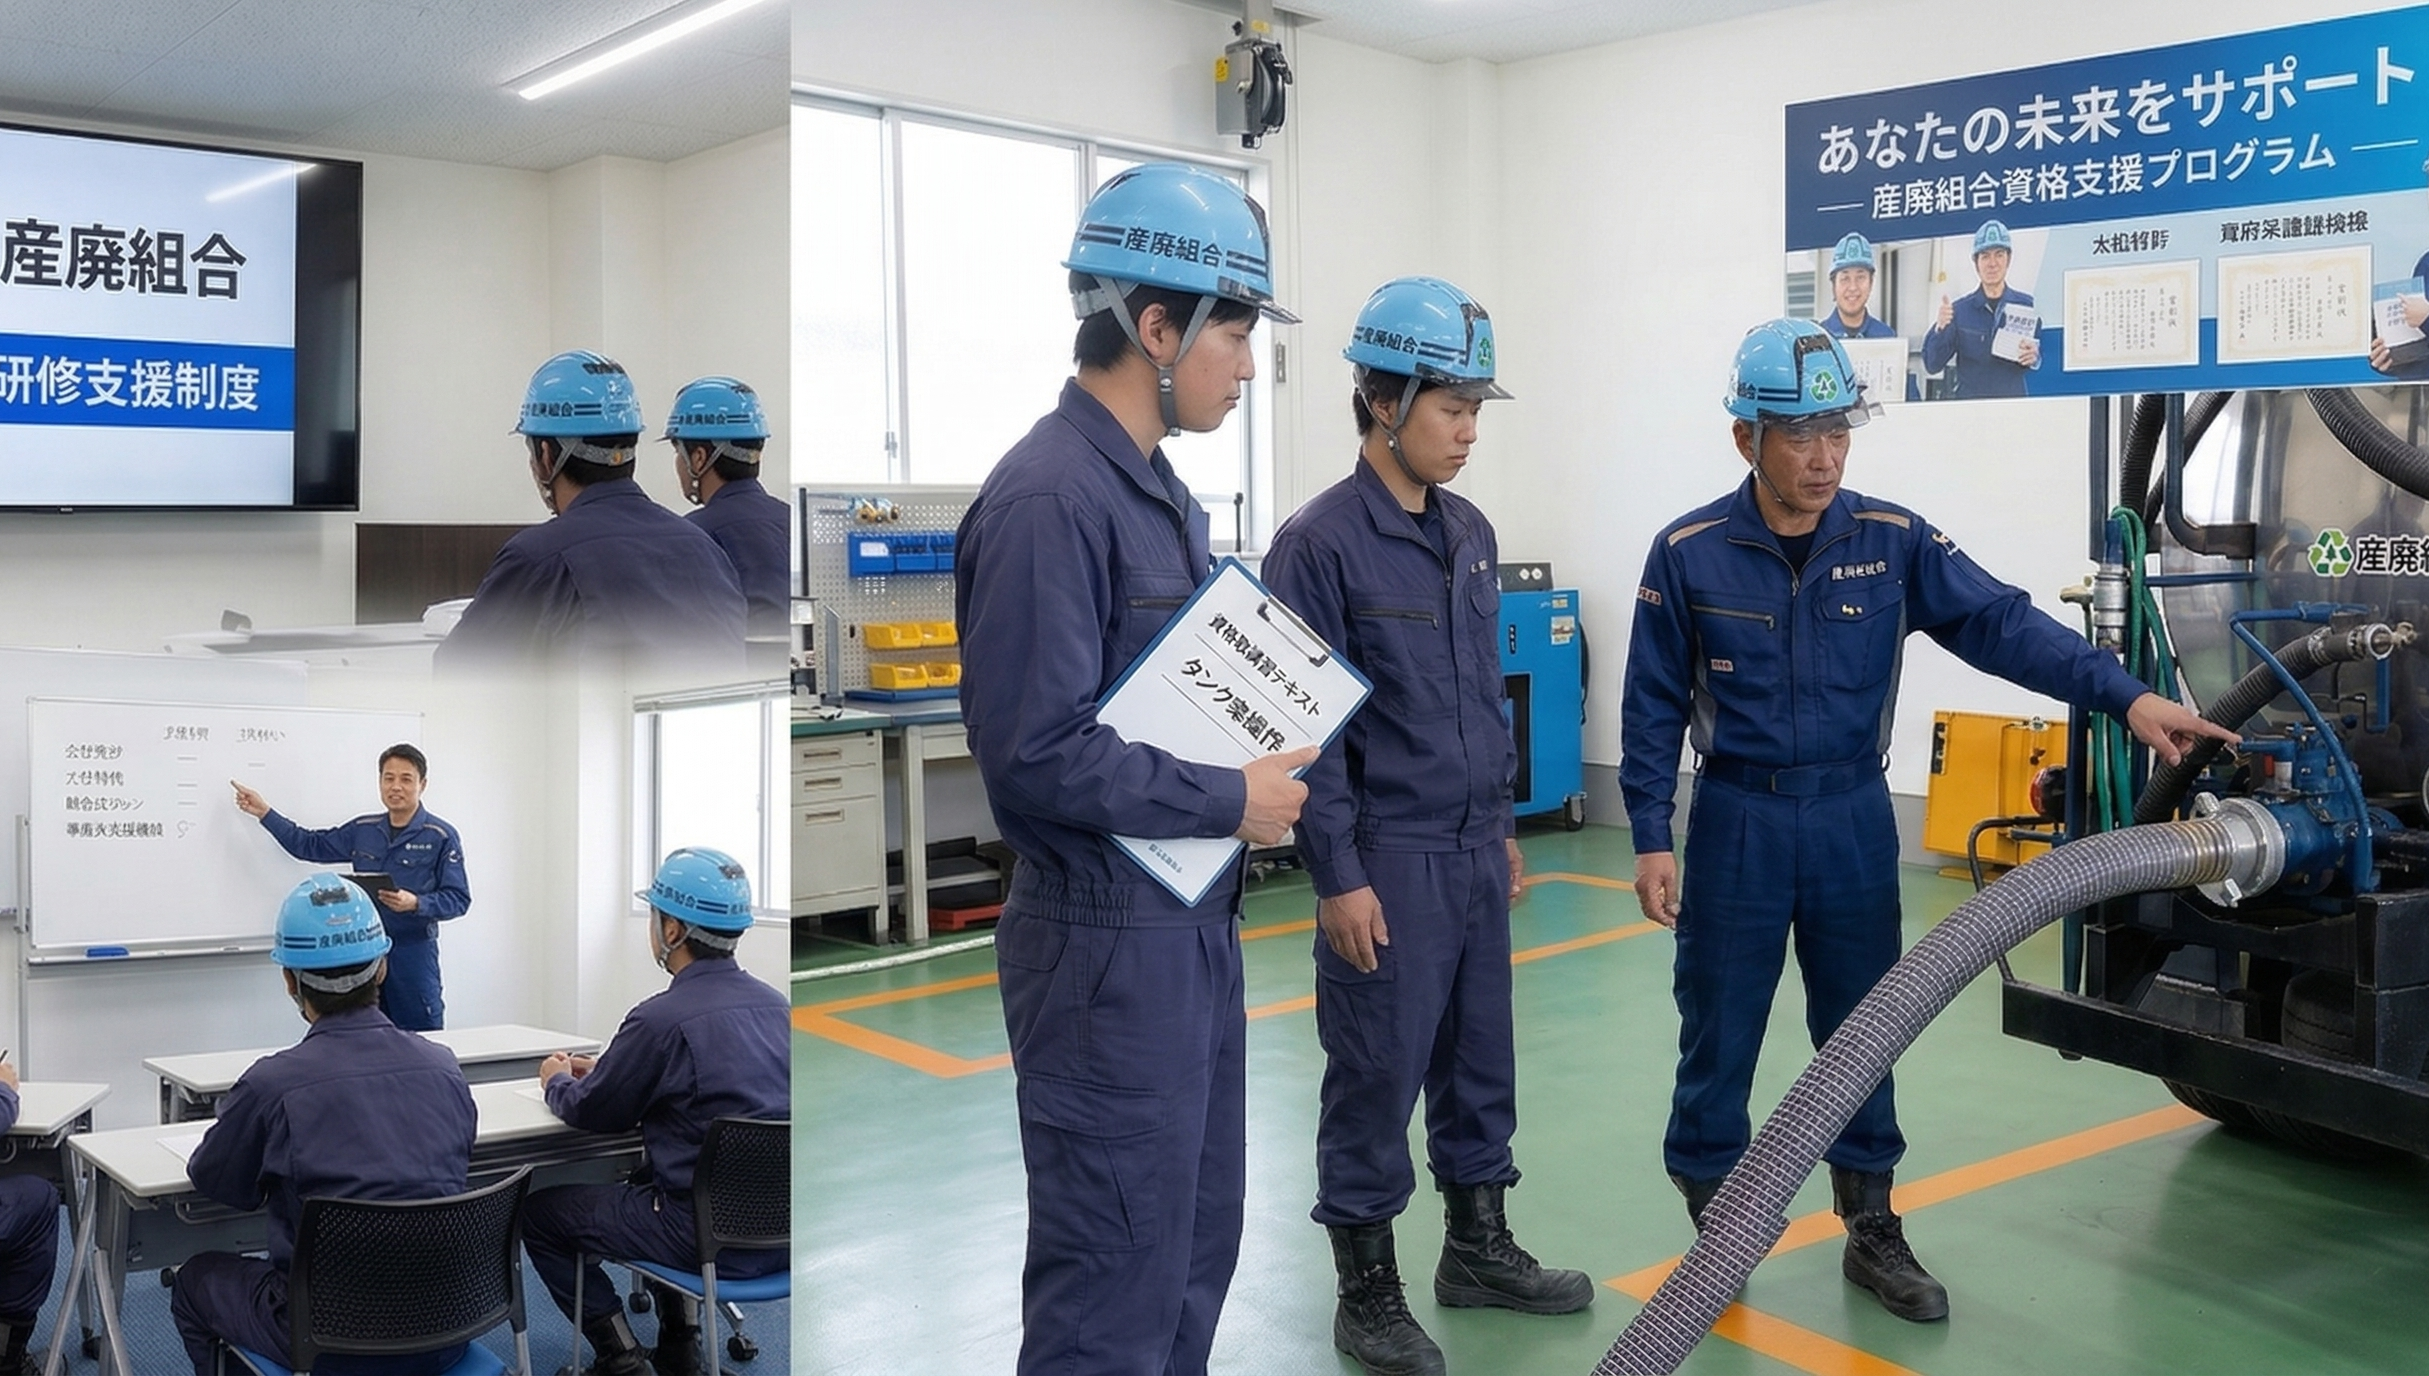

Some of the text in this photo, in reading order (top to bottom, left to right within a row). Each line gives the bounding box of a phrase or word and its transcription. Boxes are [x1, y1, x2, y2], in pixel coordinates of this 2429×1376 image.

[1817, 46, 2415, 175] あなたの未来をサポート
[1872, 132, 2336, 220] 産廃組合資格支援プログラム
[1, 218, 247, 300] 産廃組合
[1124, 226, 1222, 268] 産廃組合
[0, 355, 260, 411] 研修支援制度
